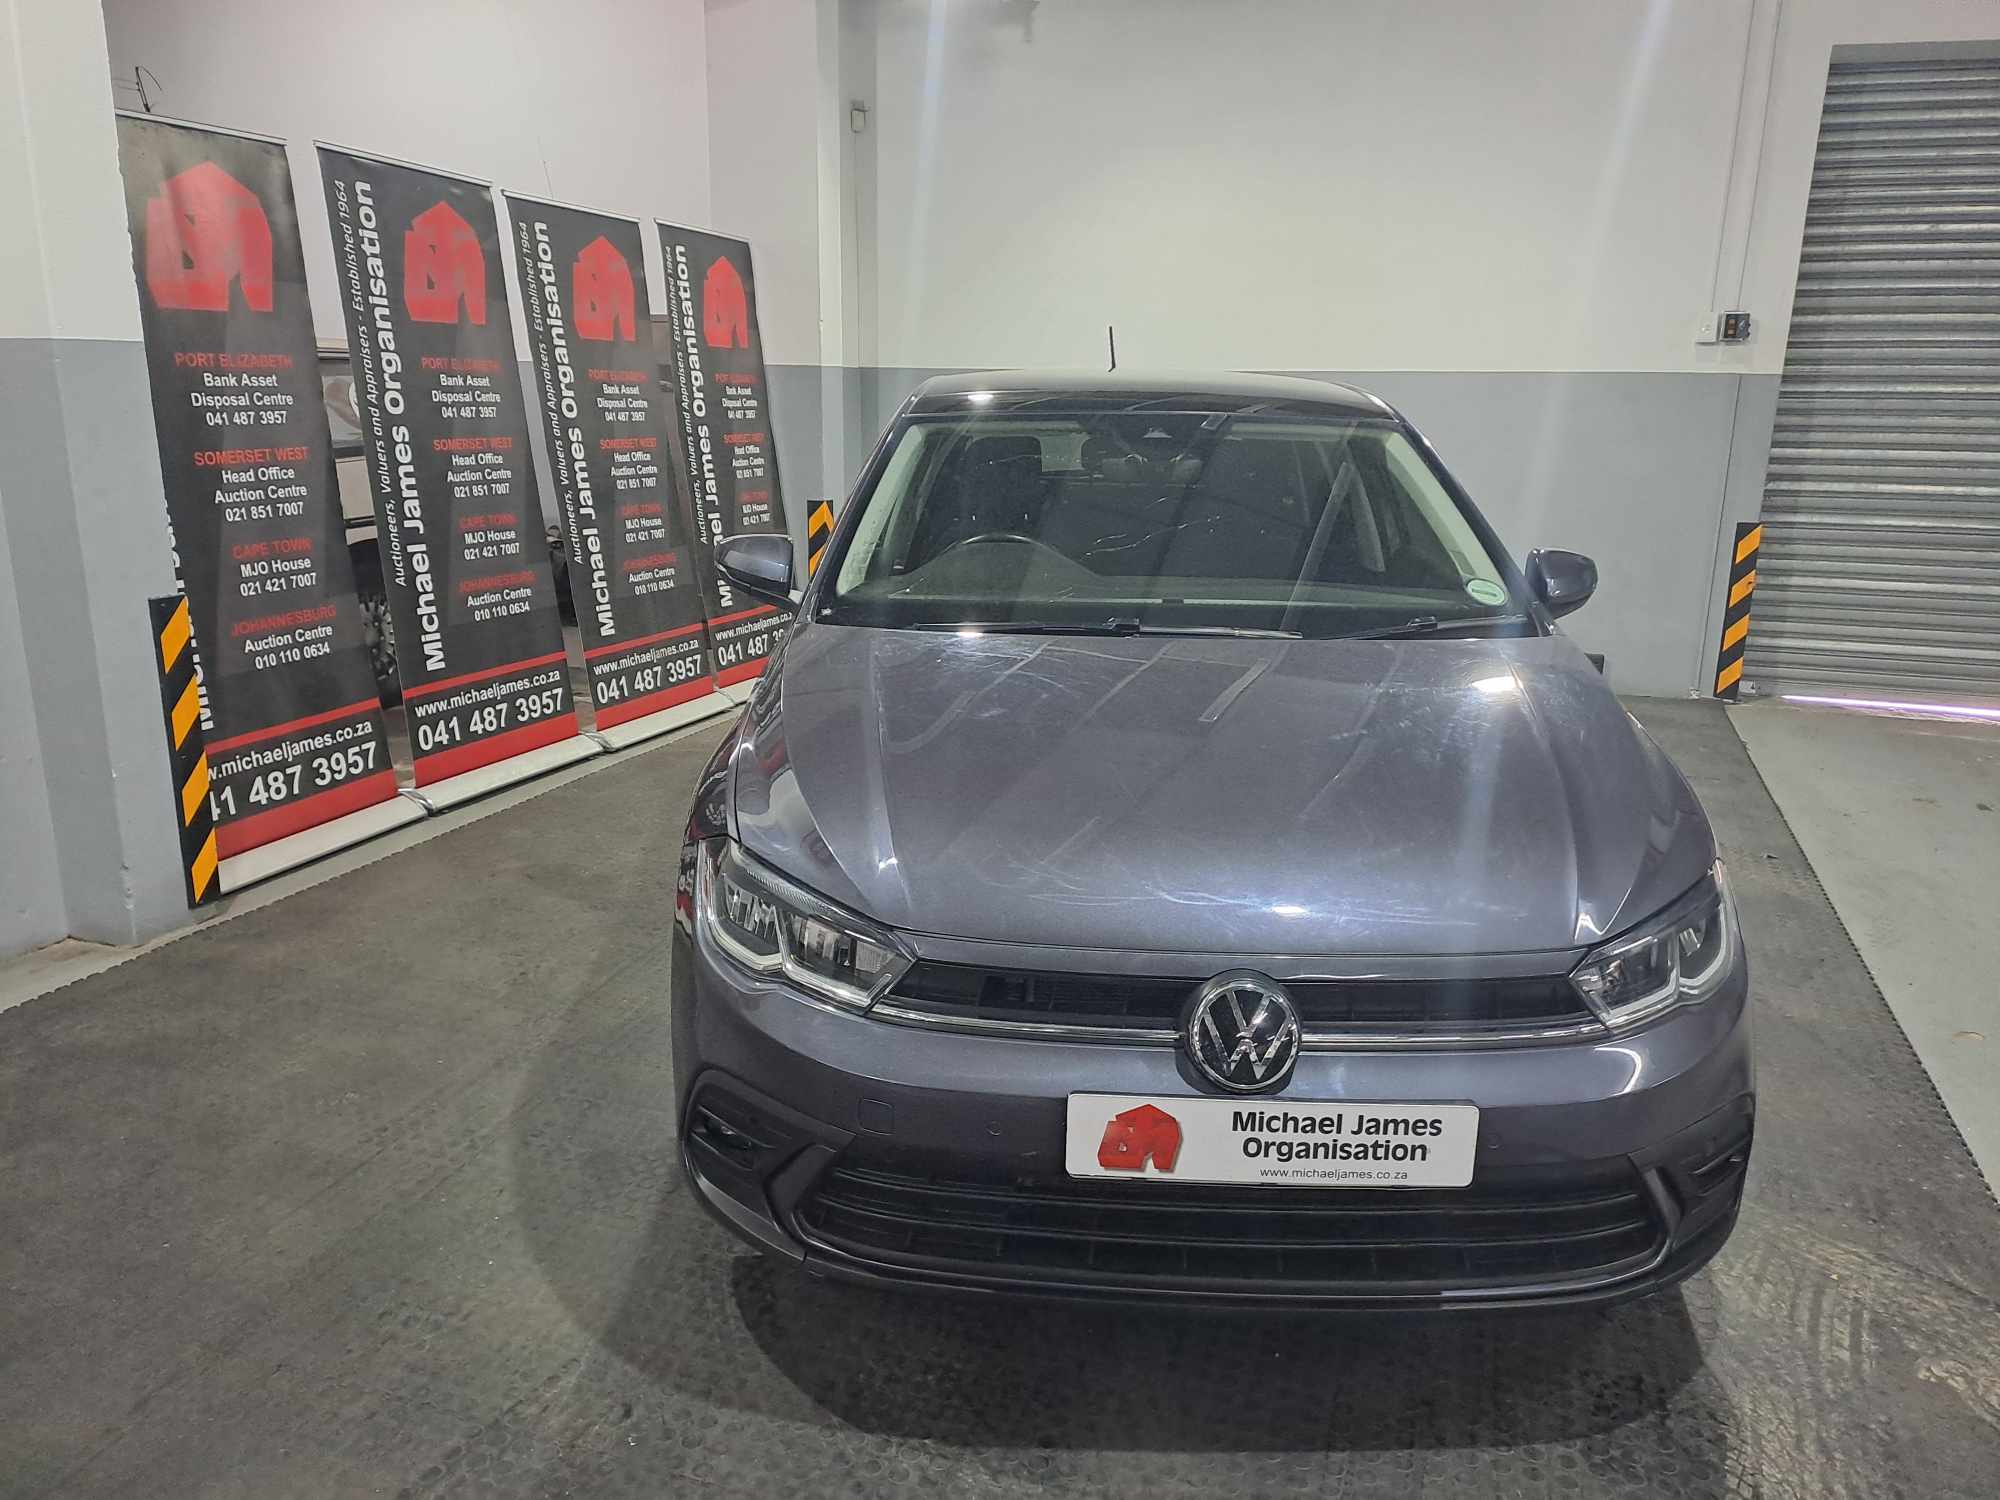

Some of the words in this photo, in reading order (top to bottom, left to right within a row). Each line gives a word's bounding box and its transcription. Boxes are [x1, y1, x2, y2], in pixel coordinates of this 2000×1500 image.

[334, 180, 351, 219] 1964
[340, 223, 364, 312] Established
[354, 181, 405, 415] Organisation
[525, 259, 544, 333] Established
[533, 221, 578, 419] Organisation
[675, 244, 706, 418] Organisation
[174, 352, 214, 368] PORT
[359, 325, 384, 404] Appraisers
[203, 373, 238, 387] Bank
[241, 374, 278, 387] Asset
[439, 374, 464, 387] Bank
[538, 344, 561, 408] Appraisers
[190, 392, 250, 409] Disposal
[252, 392, 294, 406] Centre
[431, 390, 473, 405] Disposal
[474, 391, 500, 402] Centre
[206, 412, 230, 426] 041
[233, 411, 255, 425] 487
[260, 410, 287, 424] 3957
[367, 406, 383, 436] and
[441, 407, 457, 418] 041
[460, 407, 476, 418] 487
[548, 412, 562, 438] and
[683, 412, 693, 434] and
[194, 449, 272, 465] SOMERSET
[275, 446, 309, 461] WEST
[374, 440, 393, 493] Valuers
[451, 454, 475, 466] Head
[477, 453, 503, 464] Office
[554, 438, 570, 486] Valuers
[686, 431, 699, 476] Valuers
[697, 424, 719, 506] James
[222, 469, 255, 483] Head
[258, 466, 295, 480] Office
[391, 425, 424, 534] James
[447, 470, 482, 482] Auction
[484, 468, 512, 480] Centre
[567, 427, 596, 520] James
[214, 488, 265, 504] Auction
[267, 485, 308, 499] Centre
[453, 486, 470, 498] 021
[472, 484, 488, 496] 851
[490, 483, 510, 495] 7007
[225, 507, 247, 521] 021
[250, 505, 273, 519] 851
[276, 502, 304, 517] 7007
[693, 480, 708, 545] Auctioneers,
[464, 532, 484, 545] MJO
[486, 530, 516, 541] House
[563, 490, 583, 565] Auctioneers,
[384, 499, 407, 586] Auctioneers,
[464, 548, 479, 560] 021
[482, 546, 497, 558] 421
[499, 543, 520, 555] 7007
[240, 561, 268, 578] MJO
[271, 558, 312, 573] House
[582, 527, 616, 637] Michael
[240, 581, 262, 597] 021
[264, 578, 287, 592] 421
[289, 573, 317, 588] 7007
[467, 592, 502, 607] Auction
[503, 587, 532, 600] Centre
[407, 543, 446, 671] Michael
[474, 608, 490, 621] 010
[492, 605, 507, 618] 110
[509, 601, 531, 615] 0634
[244, 635, 292, 653] Auction
[295, 626, 333, 642] Centre
[718, 641, 743, 666] 041
[747, 633, 769, 656] 487
[254, 652, 277, 670] 010
[279, 647, 300, 663] 110
[303, 642, 331, 659] 0634
[593, 639, 699, 676] www.michaeljames.co.za
[597, 675, 629, 704] 041
[634, 665, 661, 692] 487
[666, 653, 702, 683] 3957
[415, 670, 560, 717] www.michaeljames.co.za
[418, 716, 460, 751] 041
[469, 702, 508, 734] 487
[515, 687, 563, 722] 3957
[249, 765, 302, 806] 487
[312, 741, 376, 786] 3957
[1232, 1111, 1343, 1134] Michael
[1350, 1114, 1442, 1137] James
[1242, 1137, 1428, 1163] Organisation
[1260, 1168, 1407, 1181] www.michaeljames.co.za
